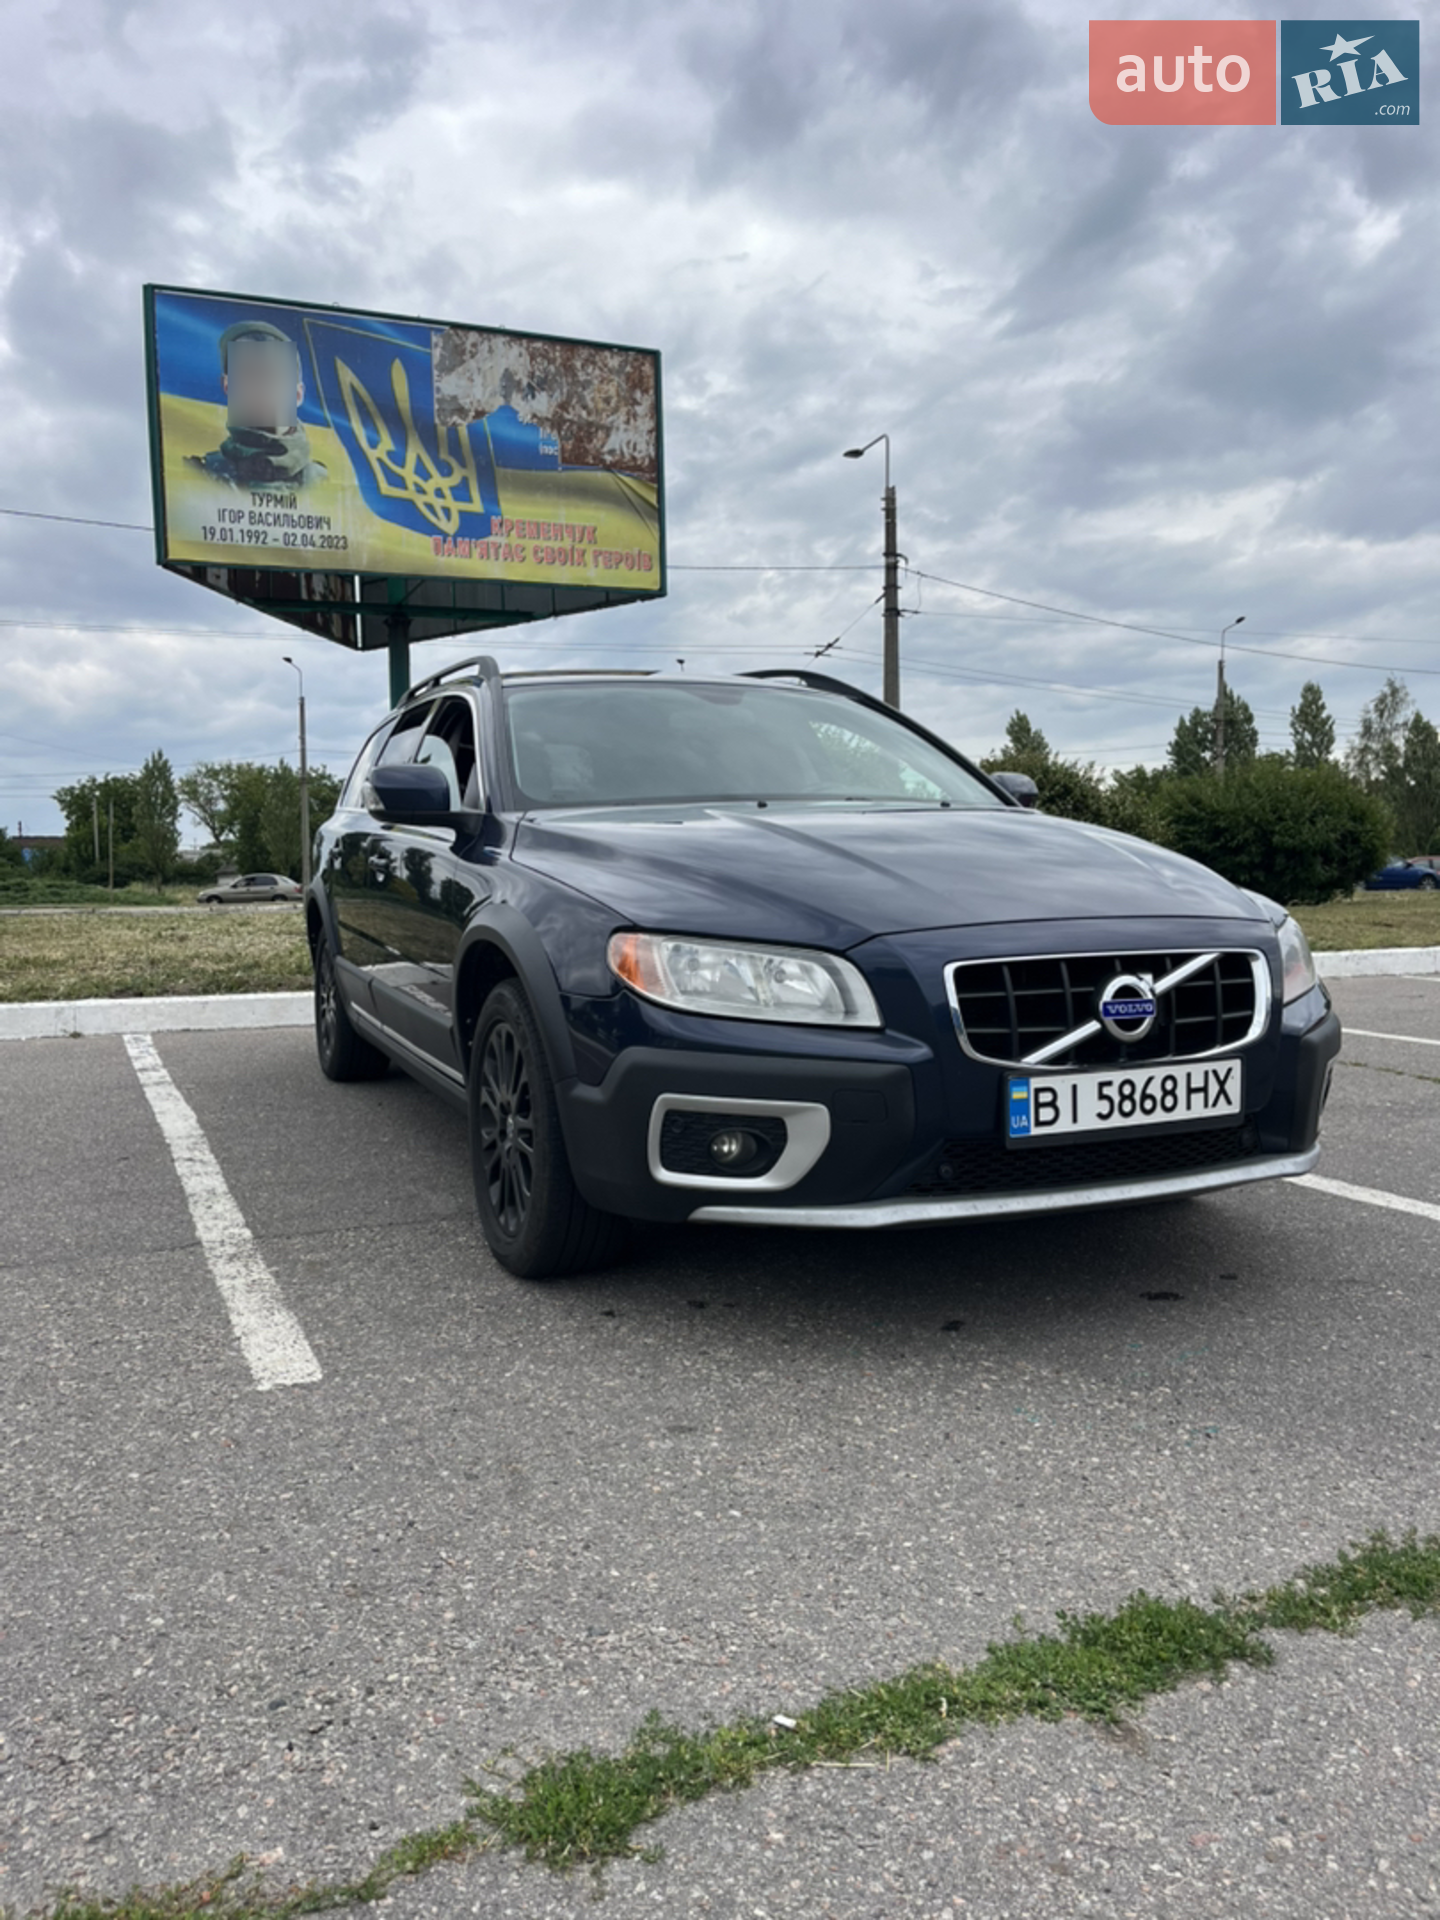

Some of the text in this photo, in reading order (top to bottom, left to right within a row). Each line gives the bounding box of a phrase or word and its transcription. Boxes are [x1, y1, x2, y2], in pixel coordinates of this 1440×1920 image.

[250, 491, 297, 510] ТУРМІЙ
[217, 507, 332, 531] ІГОР ВАСИЛЬОВИЧ
[490, 516, 598, 544] КРЕМЕНЧУК
[202, 525, 268, 545] 19.01.1992
[282, 531, 349, 550] 02.04.2023
[532, 543, 587, 567] СВОЇХ
[592, 547, 654, 572] ГЕРОЇВ
[1106, 1003, 1153, 1014] VOLVO
[1010, 1114, 1029, 1128] UA
